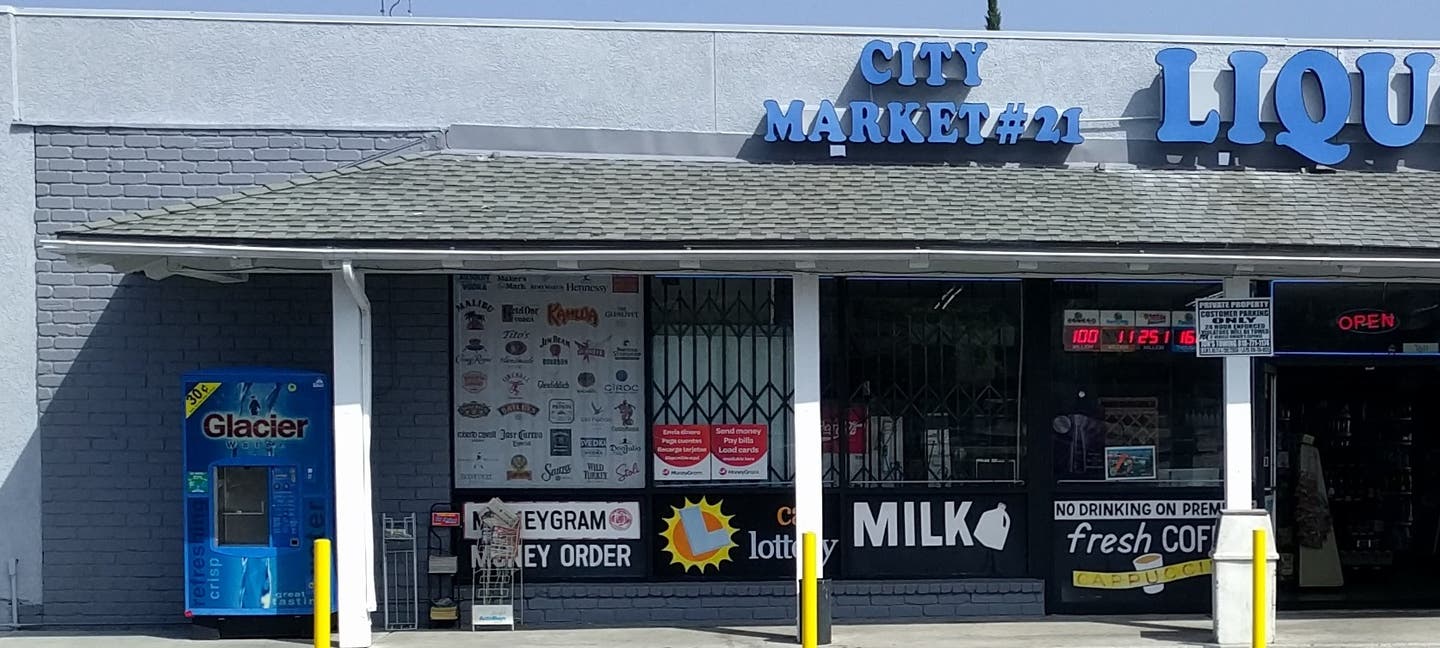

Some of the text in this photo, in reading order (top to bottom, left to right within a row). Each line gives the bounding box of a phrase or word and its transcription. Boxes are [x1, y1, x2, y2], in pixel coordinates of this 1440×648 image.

[858, 39, 988, 86] CITY
[566, 283, 607, 293] Hennessy
[456, 299, 495, 312] MALIBU
[1337, 312, 1397, 331] OPEN
[1072, 328, 1100, 344] 100
[203, 414, 308, 438] Glacier
[736, 427, 762, 435] money
[723, 435, 737, 444] Pay
[472, 510, 606, 530] MEYGRAM
[1056, 502, 1075, 516] NO
[1080, 502, 1152, 516] DRINKING
[1155, 502, 1176, 516] ON
[853, 501, 975, 547] MILK
[748, 530, 840, 567] lotty
[1067, 521, 1153, 554] fresh
[560, 544, 632, 568] ORDER
[207, 557, 223, 600] crisp
[1075, 561, 1213, 587] CAPPUCCI
